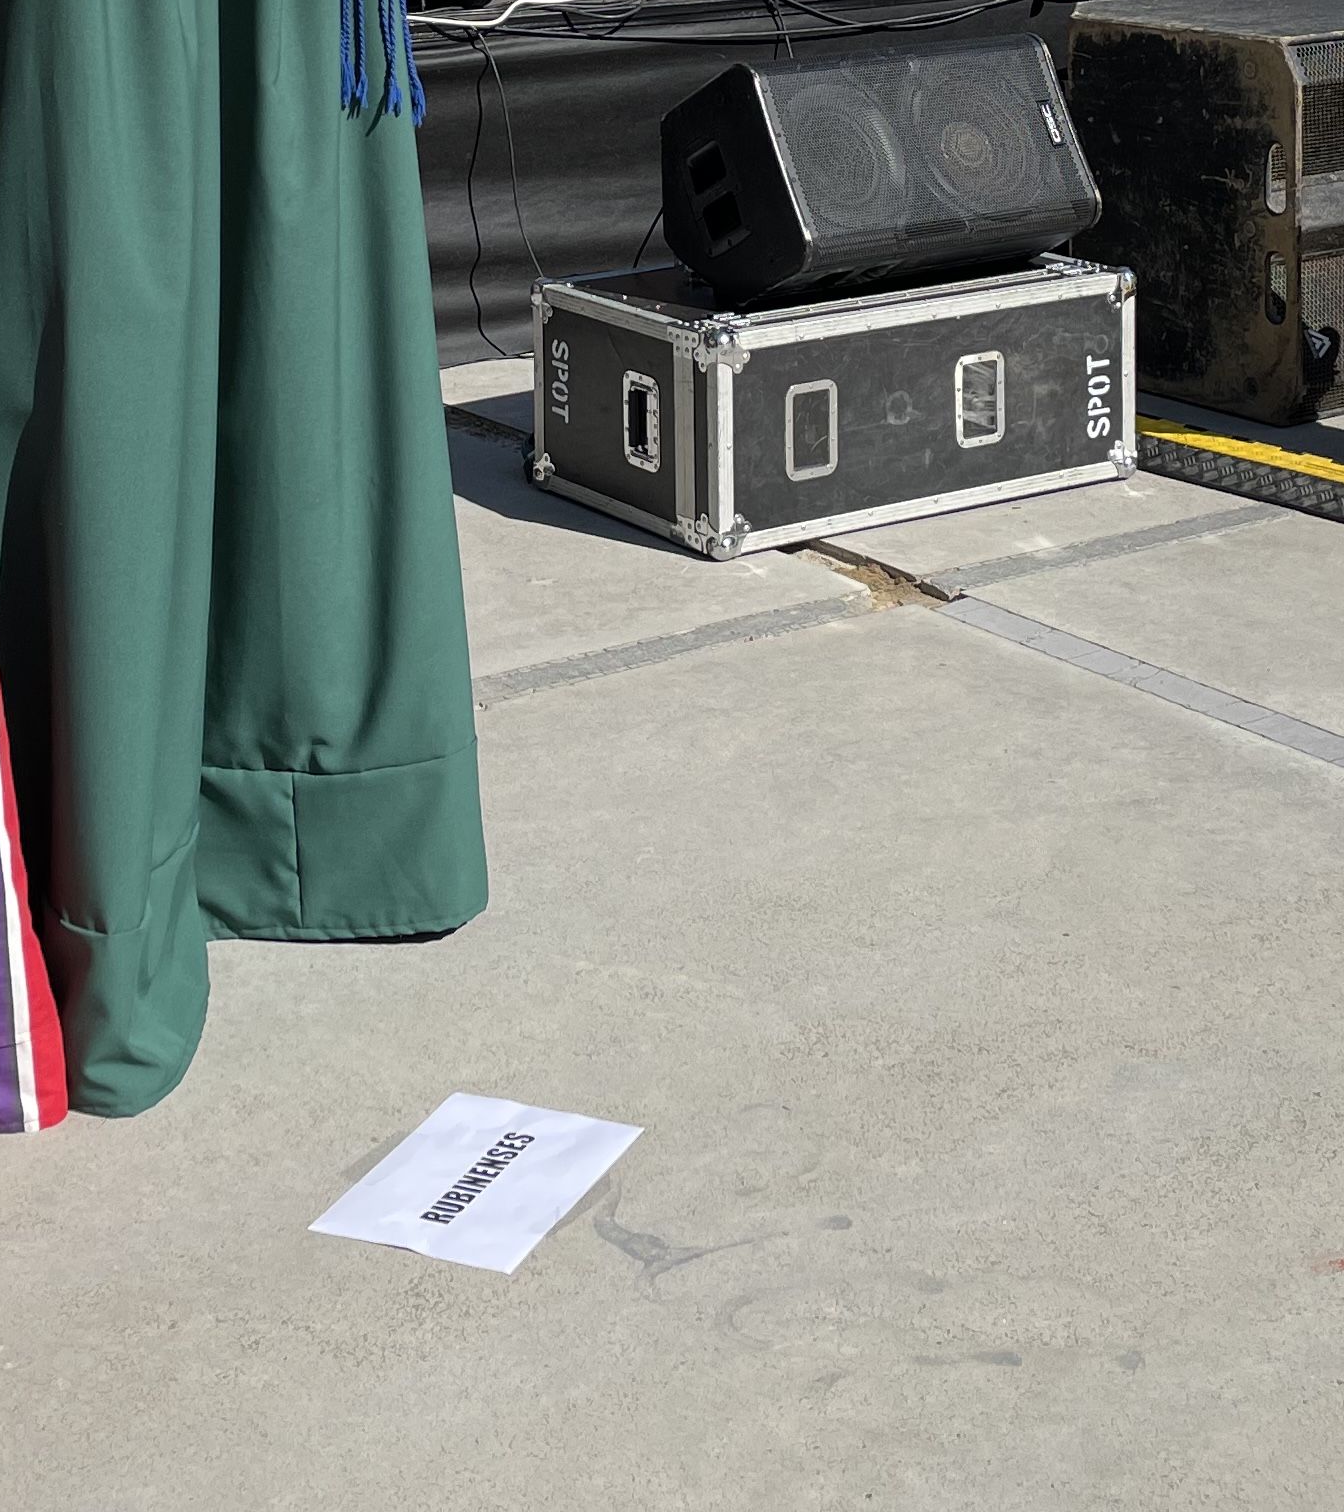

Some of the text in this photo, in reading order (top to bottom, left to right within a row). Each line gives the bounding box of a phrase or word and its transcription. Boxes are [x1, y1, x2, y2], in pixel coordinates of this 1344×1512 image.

[551, 339, 569, 424] SPOT
[1086, 355, 1111, 439] SPOT
[419, 1131, 536, 1225] RUBINENSES
